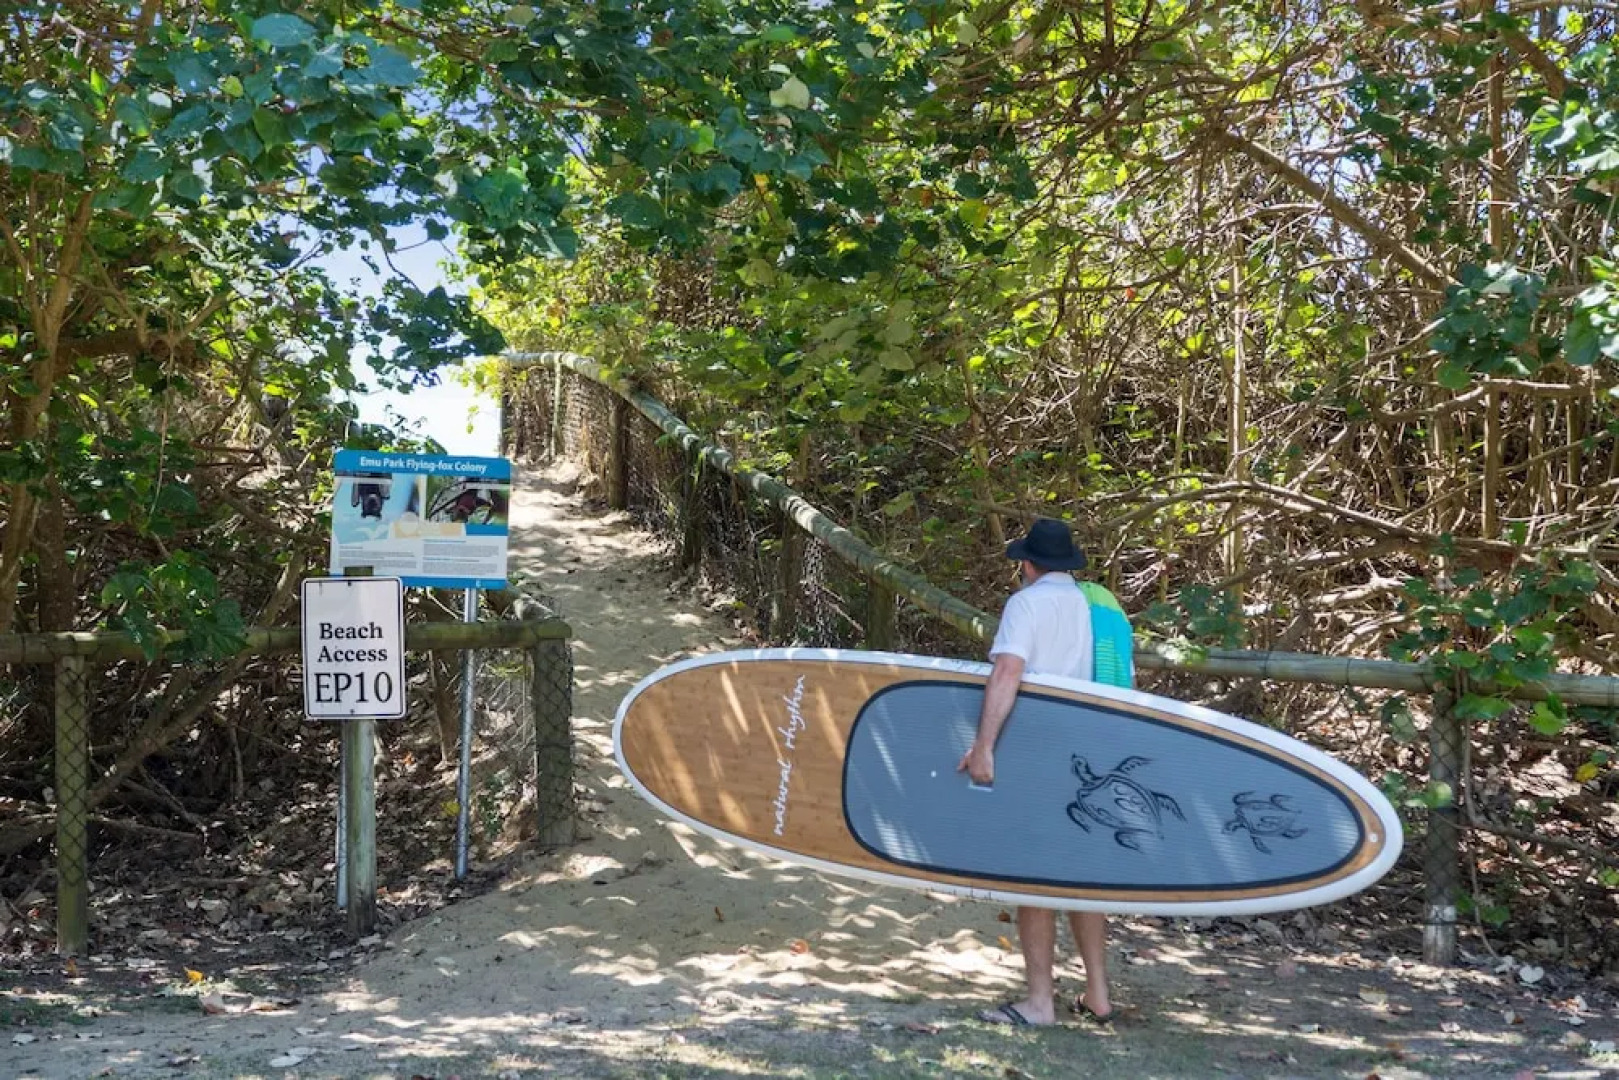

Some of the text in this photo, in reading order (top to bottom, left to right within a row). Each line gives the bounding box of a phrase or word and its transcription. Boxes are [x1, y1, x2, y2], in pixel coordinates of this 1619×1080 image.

[360, 456, 487, 474] Emu Park Flying-fox Colony
[319, 621, 384, 640] Beach
[317, 645, 388, 663] Access
[314, 671, 393, 704] EP10
[773, 674, 806, 836] natural rhythm
